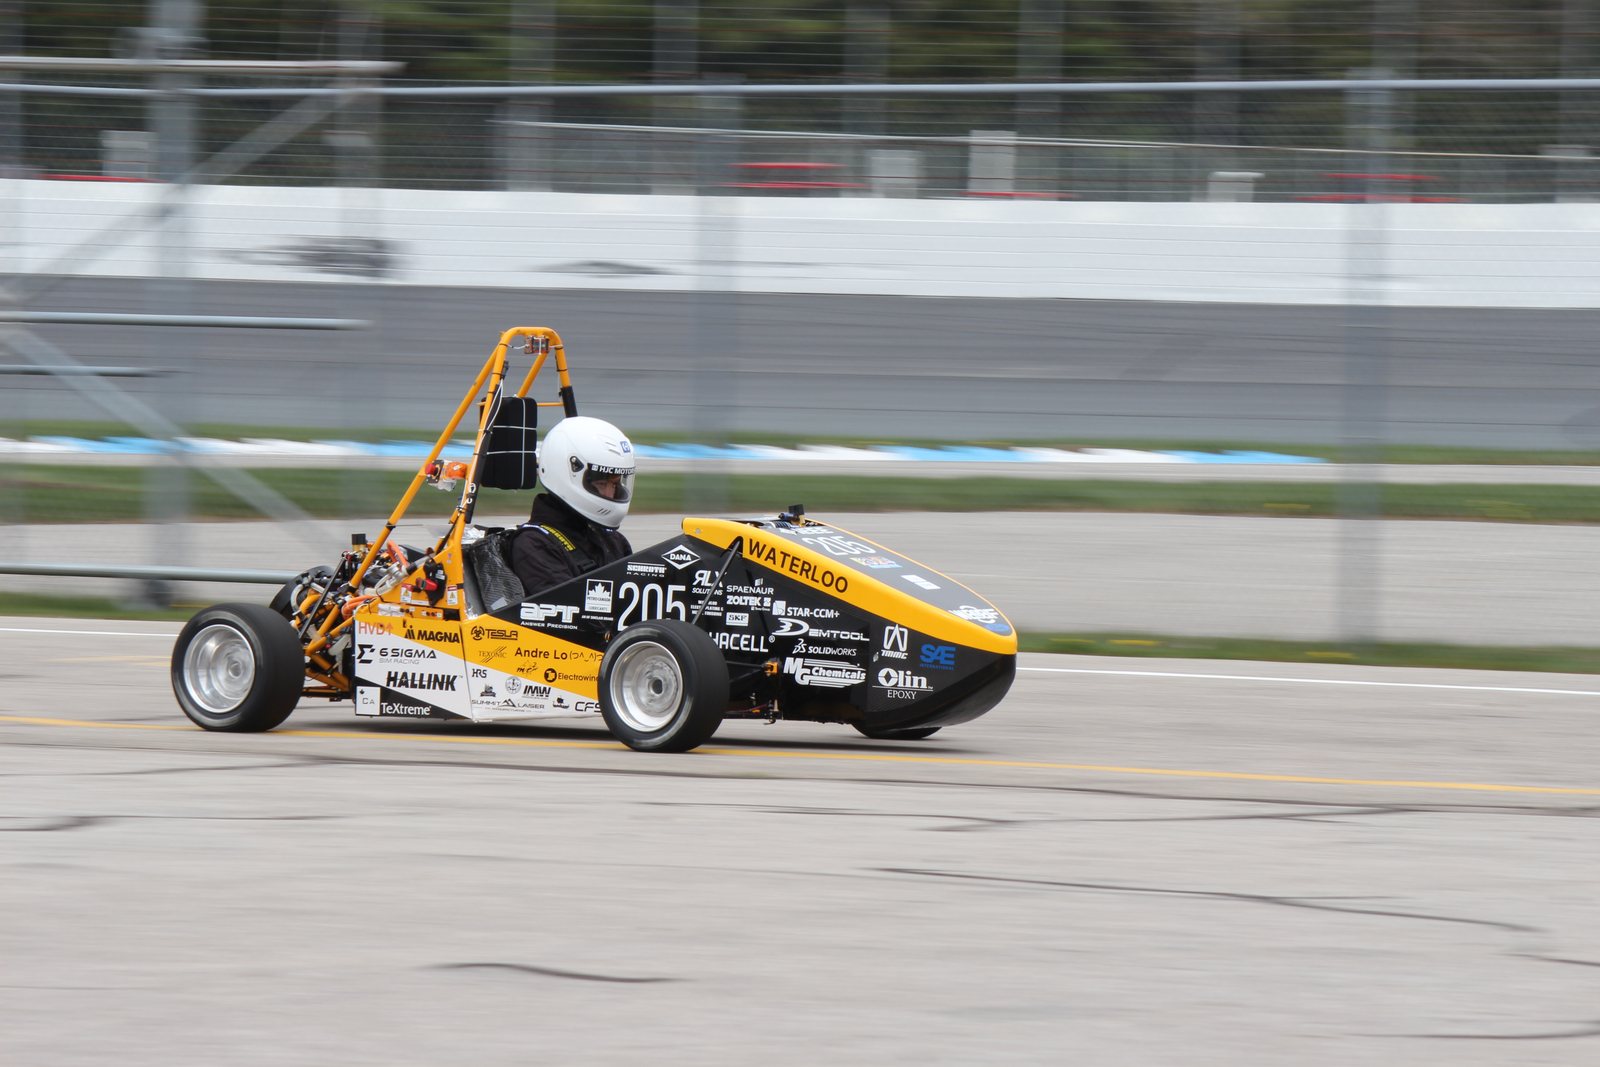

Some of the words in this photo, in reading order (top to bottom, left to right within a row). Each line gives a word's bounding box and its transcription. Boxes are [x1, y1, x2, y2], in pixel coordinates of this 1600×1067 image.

[599, 466, 613, 474] HJC
[801, 535, 877, 556] 205
[669, 553, 692, 561] DANA
[626, 564, 665, 574] SCHROTH
[749, 538, 848, 593] WATERLOO
[726, 584, 774, 595] SPAENAUR
[617, 581, 686, 631] 205
[726, 595, 762, 606] ZOLTEK
[787, 607, 840, 619] STAR-CCM+
[417, 629, 460, 643] MAGNA
[379, 647, 388, 657] 6
[391, 647, 437, 659] SIGMA
[514, 647, 549, 659] Andre
[553, 650, 568, 660] Lo
[807, 646, 857, 656] SOLIDWORKS
[919, 643, 957, 665] SAE
[471, 668, 487, 679] HRS
[811, 666, 866, 680] Chemicals
[878, 667, 928, 689] Olin
[385, 670, 458, 692] HALLINK
[887, 689, 917, 700] EPOXY
[380, 702, 431, 716] TeXtreme
